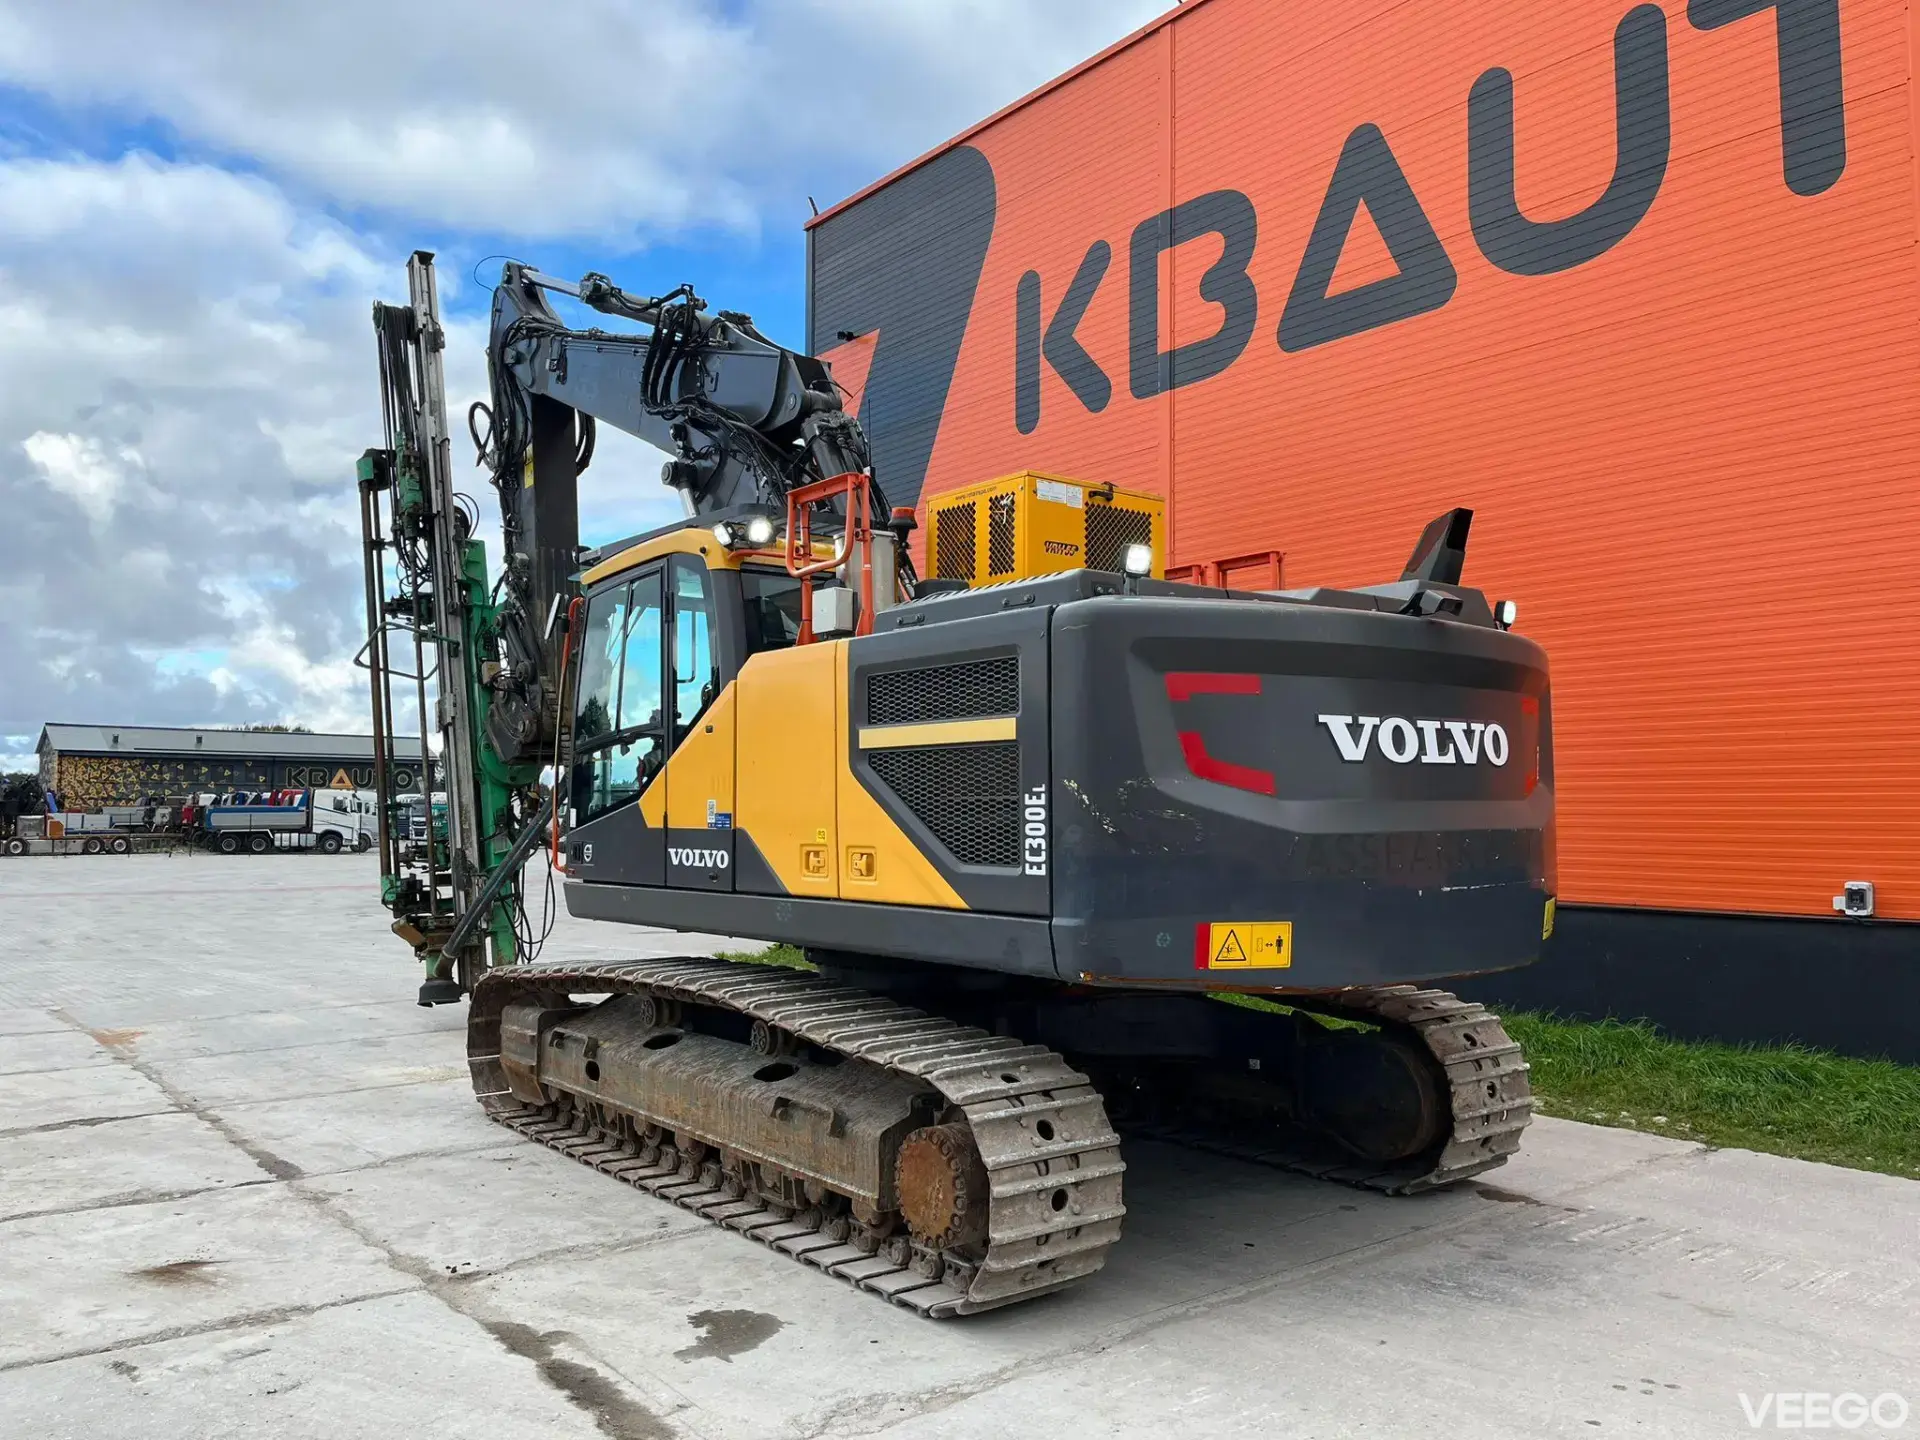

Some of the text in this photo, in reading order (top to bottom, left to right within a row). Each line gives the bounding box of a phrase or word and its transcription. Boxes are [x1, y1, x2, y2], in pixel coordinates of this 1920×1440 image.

[1317, 713, 1510, 768] VOLVO
[286, 766, 415, 791] KBAUO
[667, 847, 730, 870] VOLVO
